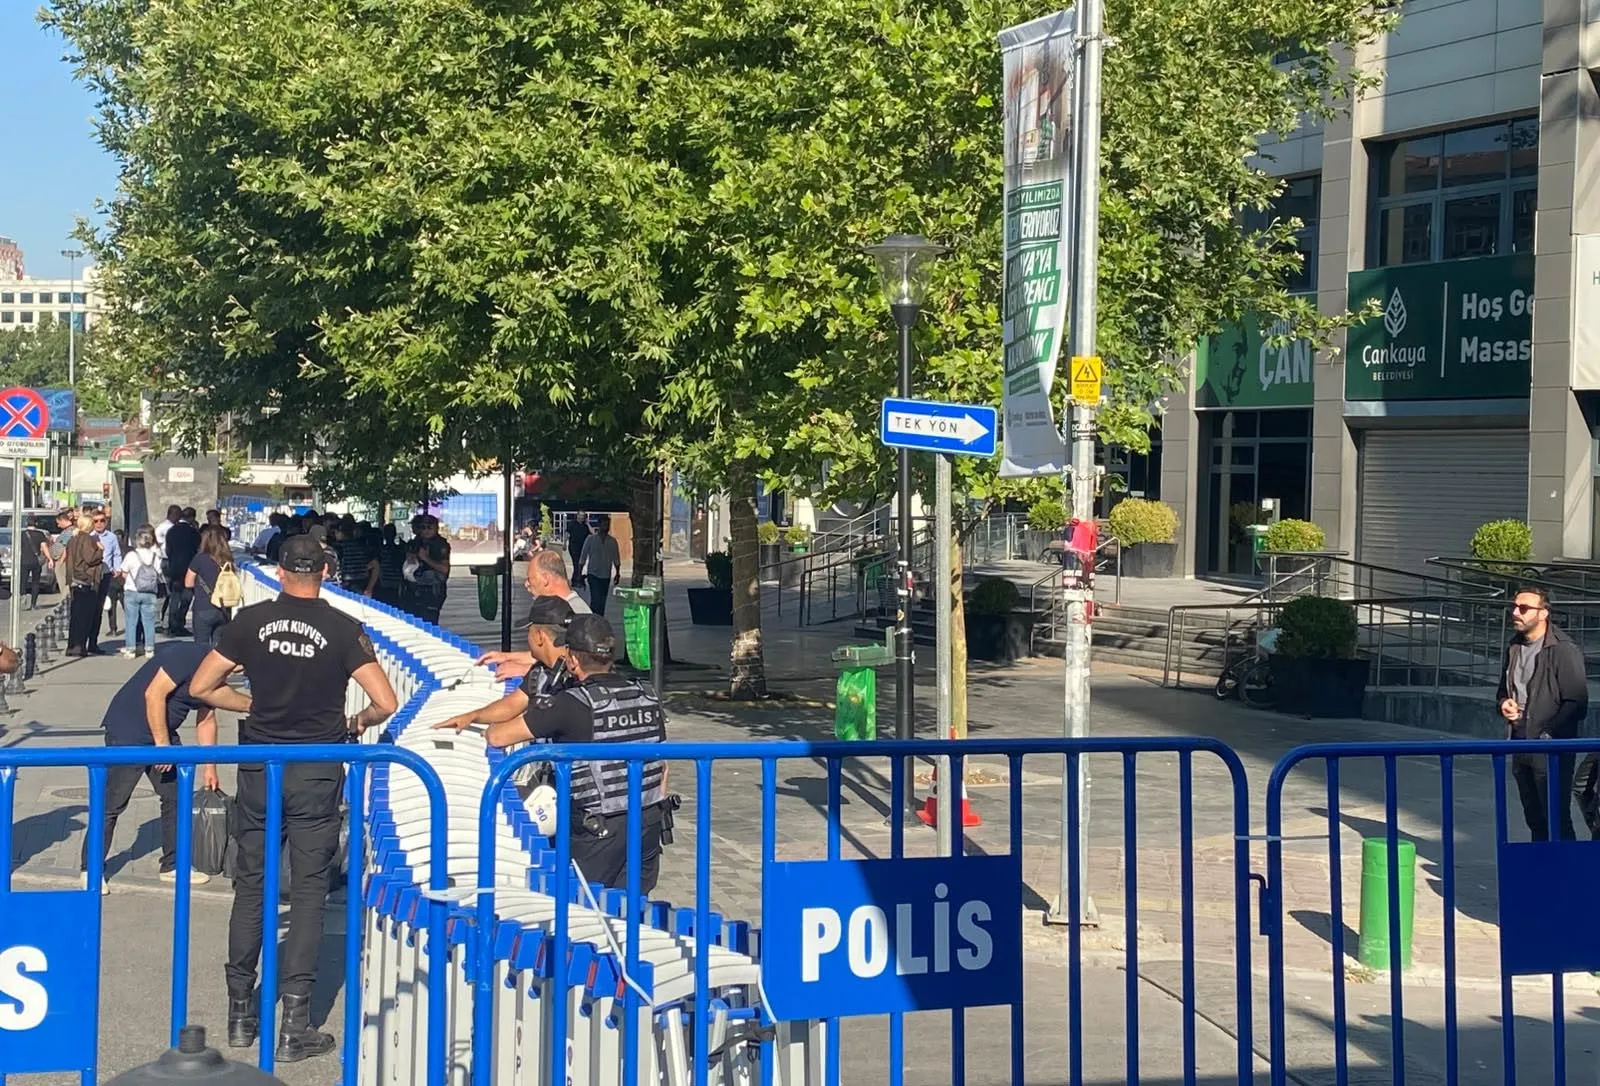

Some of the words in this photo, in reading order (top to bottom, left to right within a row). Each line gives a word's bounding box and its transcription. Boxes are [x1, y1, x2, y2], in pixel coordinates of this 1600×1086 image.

[1462, 292, 1503, 321] Hoş
[1362, 342, 1426, 368] Çankaya
[1460, 335, 1531, 363] Masas
[1258, 339, 1311, 391] ÇAN
[895, 416, 921, 430] TEK
[290, 619, 328, 650] KUVVET
[607, 710, 653, 729] POLİS
[802, 883, 994, 983] POLİS
[0, 945, 49, 1031] S
